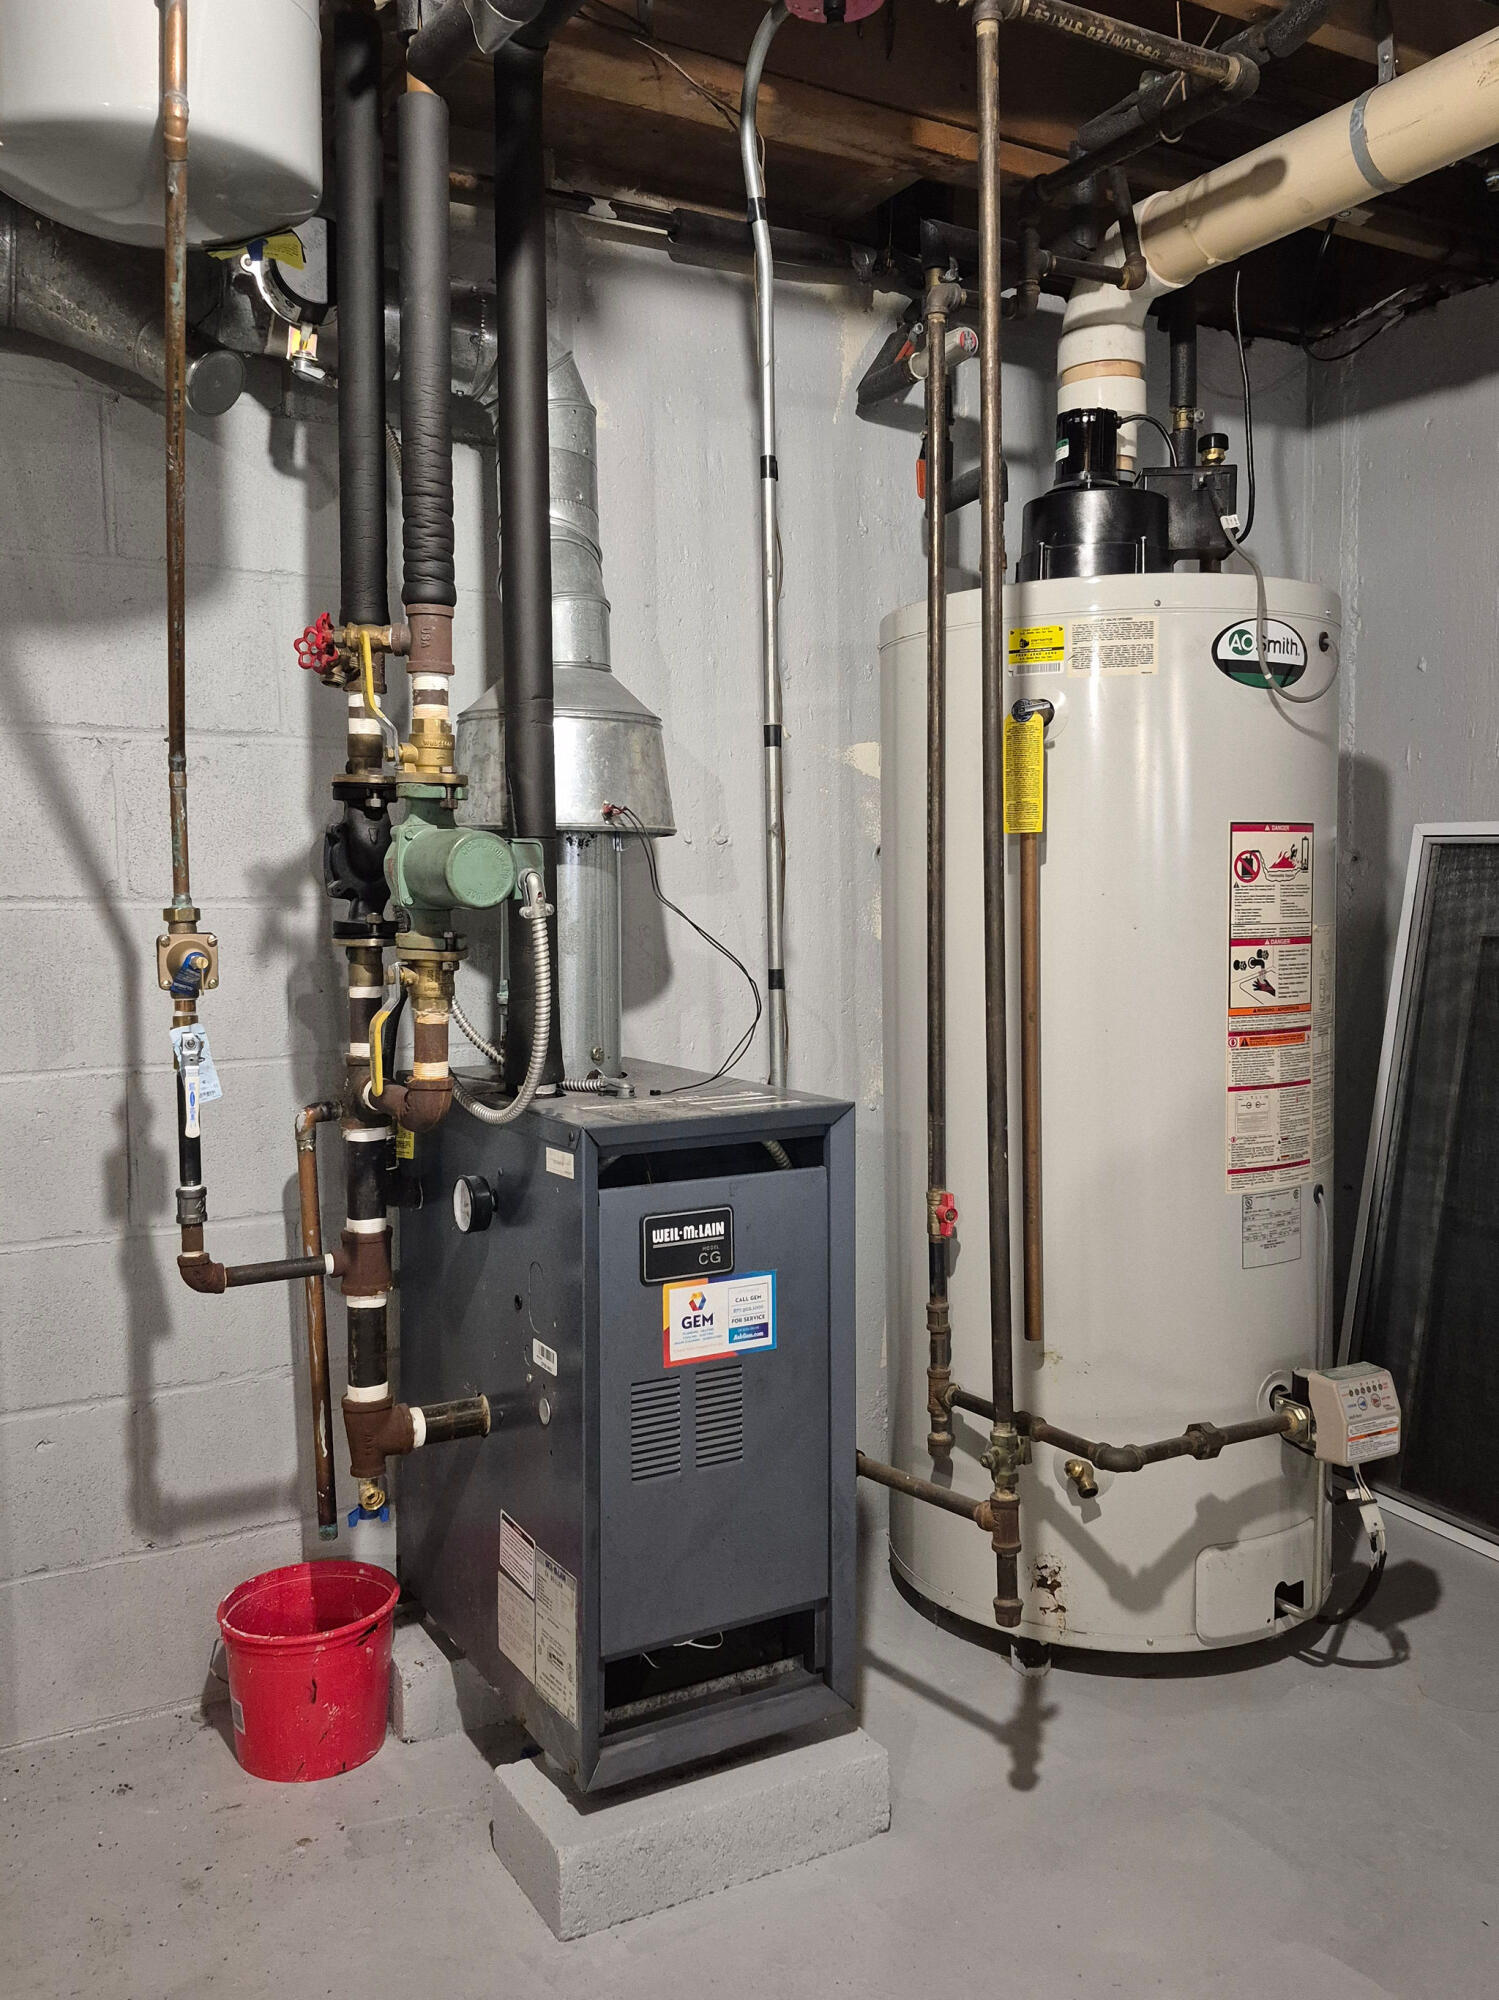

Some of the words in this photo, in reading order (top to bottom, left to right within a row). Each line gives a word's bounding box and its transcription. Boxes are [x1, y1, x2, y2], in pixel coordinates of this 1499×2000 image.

[1230, 634, 1254, 651] AO
[698, 1251, 721, 1265] CG
[681, 1313, 714, 1329] GEM
[744, 1314, 765, 1322] SERVICE
